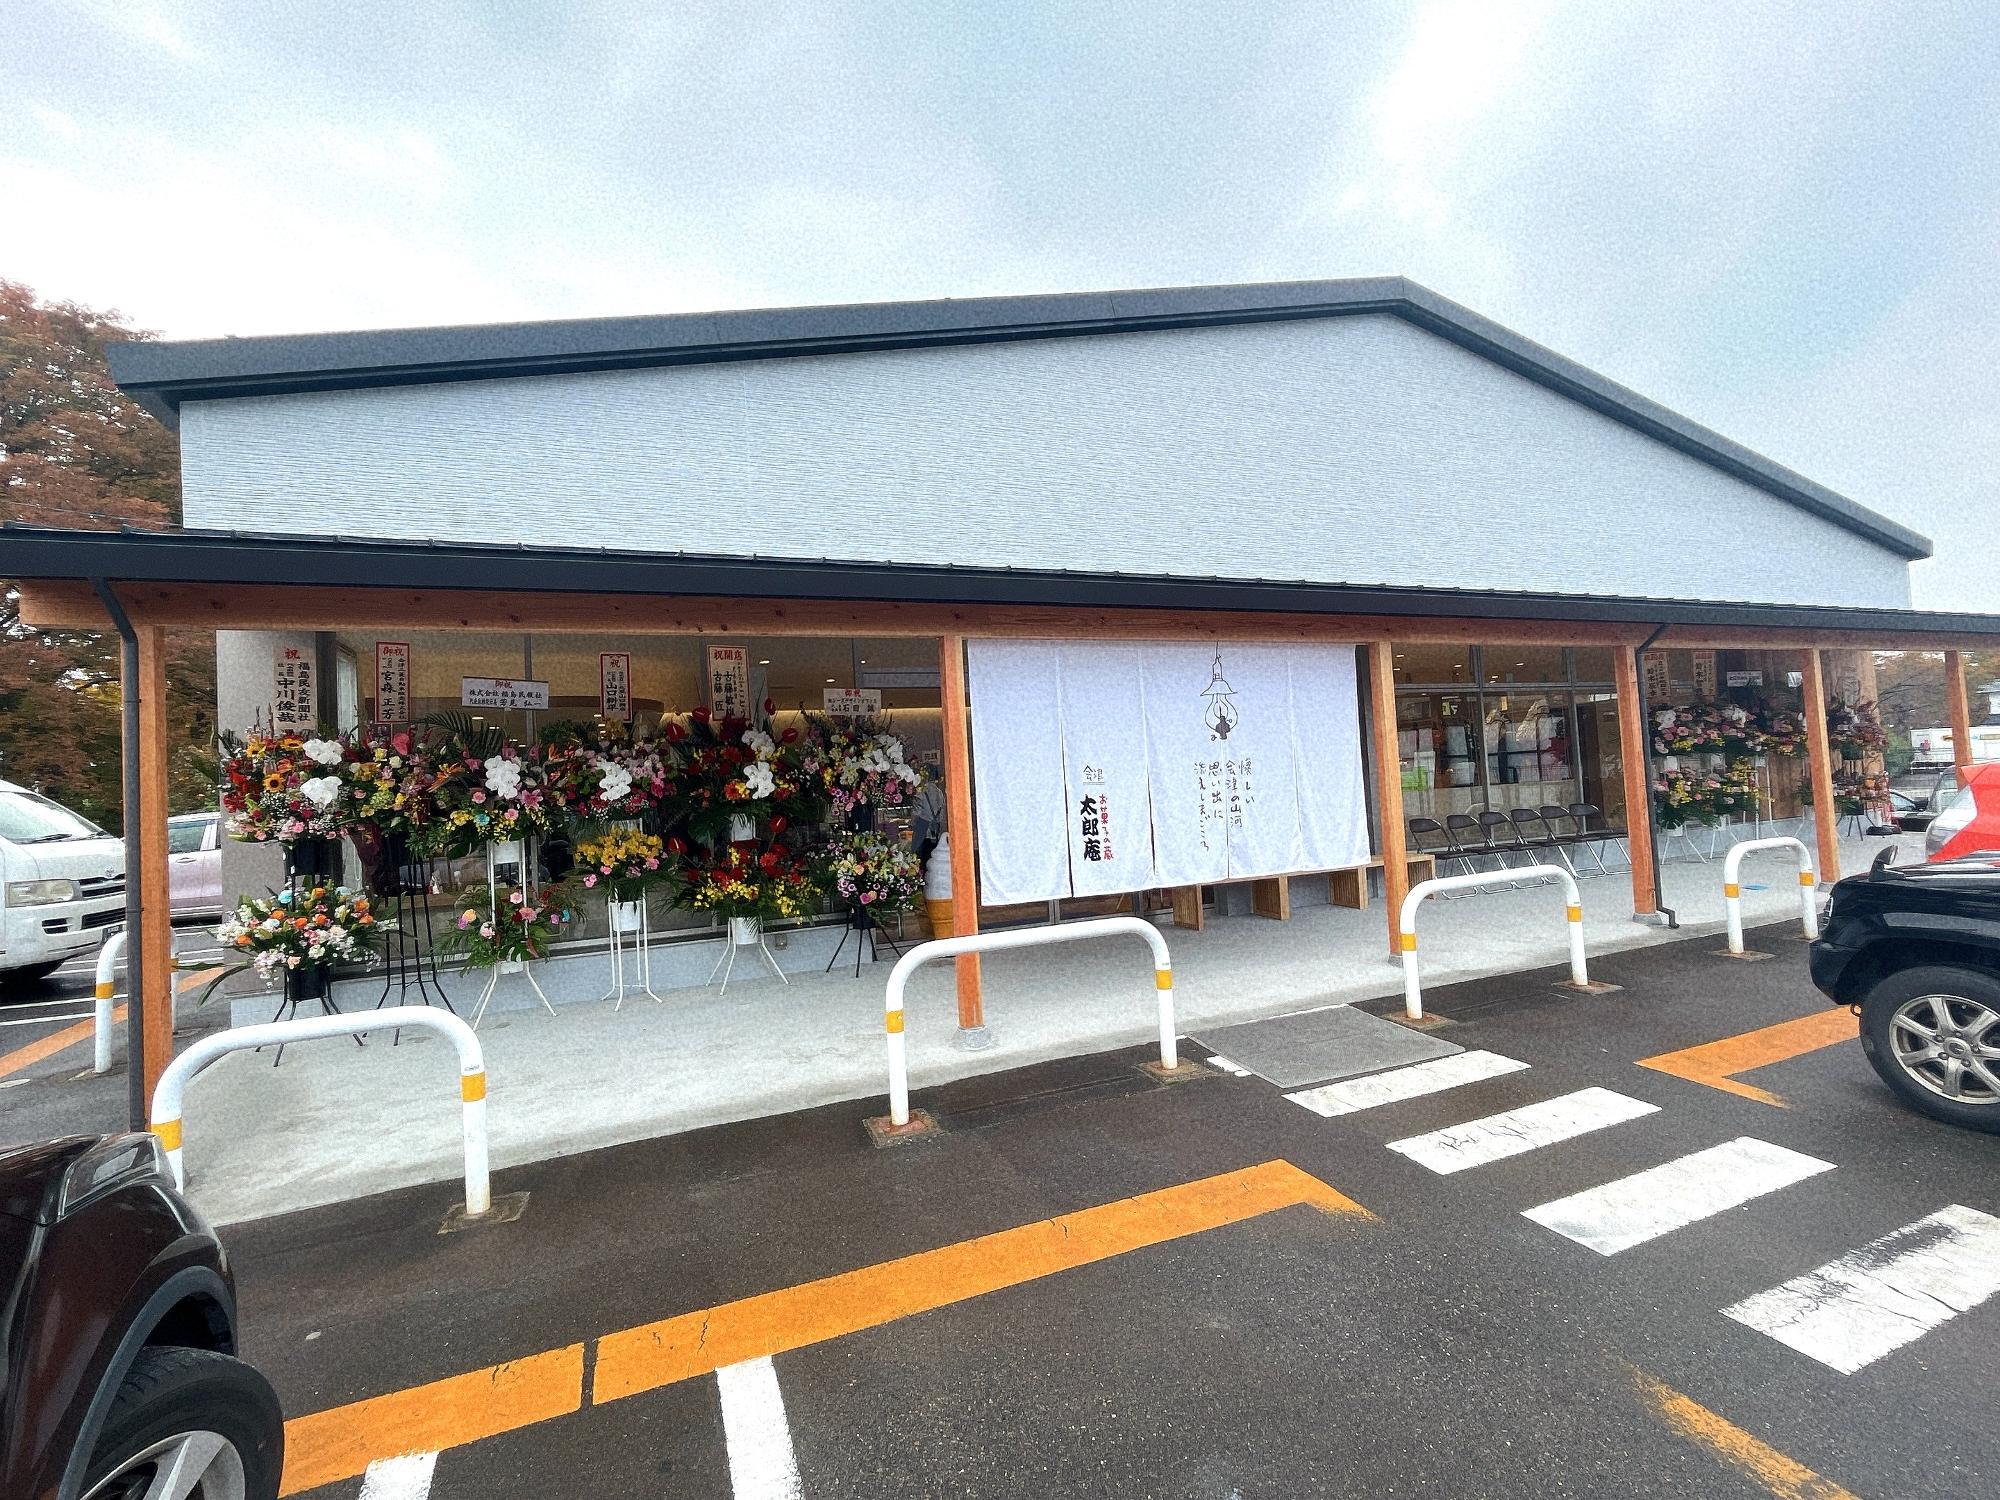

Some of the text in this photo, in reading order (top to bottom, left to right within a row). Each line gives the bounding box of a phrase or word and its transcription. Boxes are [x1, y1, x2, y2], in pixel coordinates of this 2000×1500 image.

[284, 648, 300, 660] 祝
[383, 646, 404, 656] 御祝
[713, 649, 743, 661] 祝開店
[297, 662, 311, 722] 福島民友新聞社
[495, 679, 513, 689] 御祝
[1083, 764, 1104, 782] 会津
[1208, 761, 1224, 819] 思い出に
[1225, 759, 1242, 828] 会津の山河
[1080, 793, 1101, 862] 太郎庵
[1099, 793, 1115, 861] お菓子の蔵
